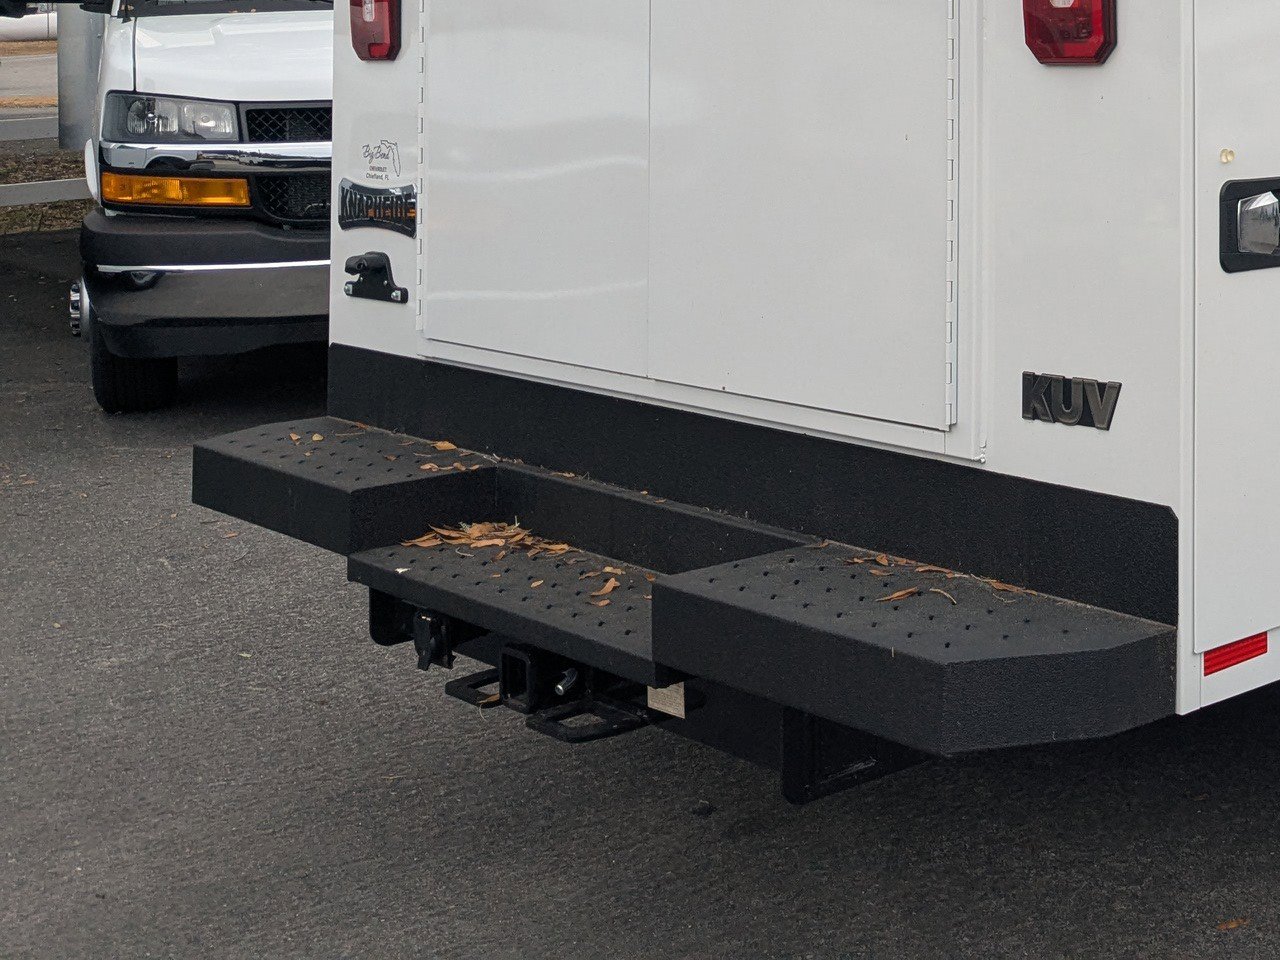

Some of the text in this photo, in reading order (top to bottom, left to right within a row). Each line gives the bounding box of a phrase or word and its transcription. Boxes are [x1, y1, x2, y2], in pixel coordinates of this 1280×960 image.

[362, 144, 374, 164] Big
[341, 186, 417, 223] KNAPHEIDE
[1022, 371, 1122, 431] KUV
